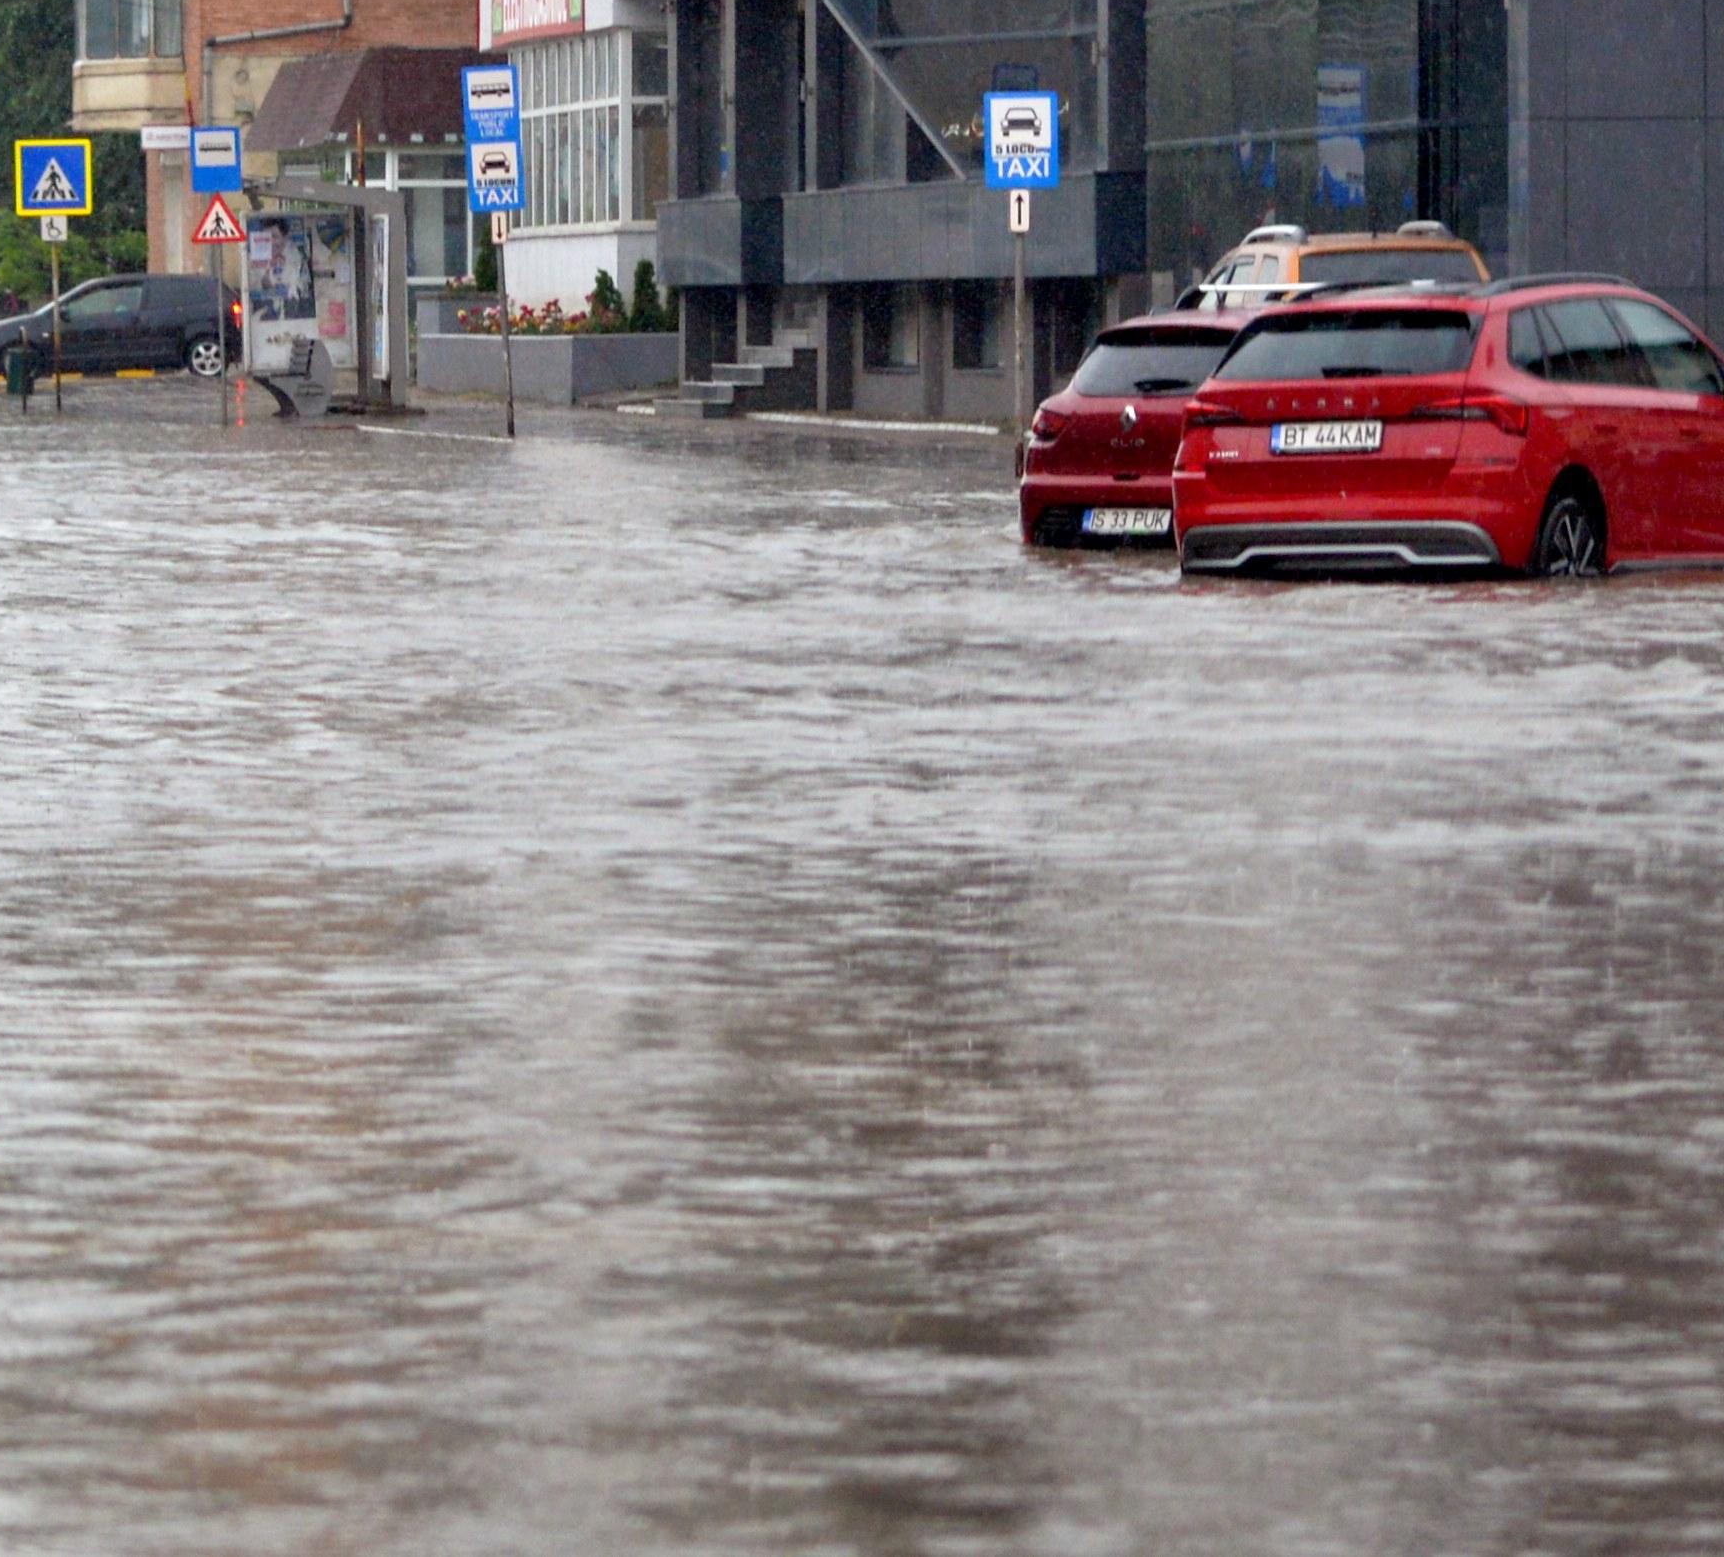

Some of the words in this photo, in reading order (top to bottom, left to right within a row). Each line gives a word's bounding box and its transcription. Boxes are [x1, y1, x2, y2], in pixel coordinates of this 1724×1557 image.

[995, 156, 1051, 179] TAXI
[476, 187, 519, 207] TAXI
[1285, 428, 1308, 445] BT
[1092, 511, 1105, 529] IS
[1110, 511, 1128, 529] 33
[1132, 510, 1166, 529] PUK
